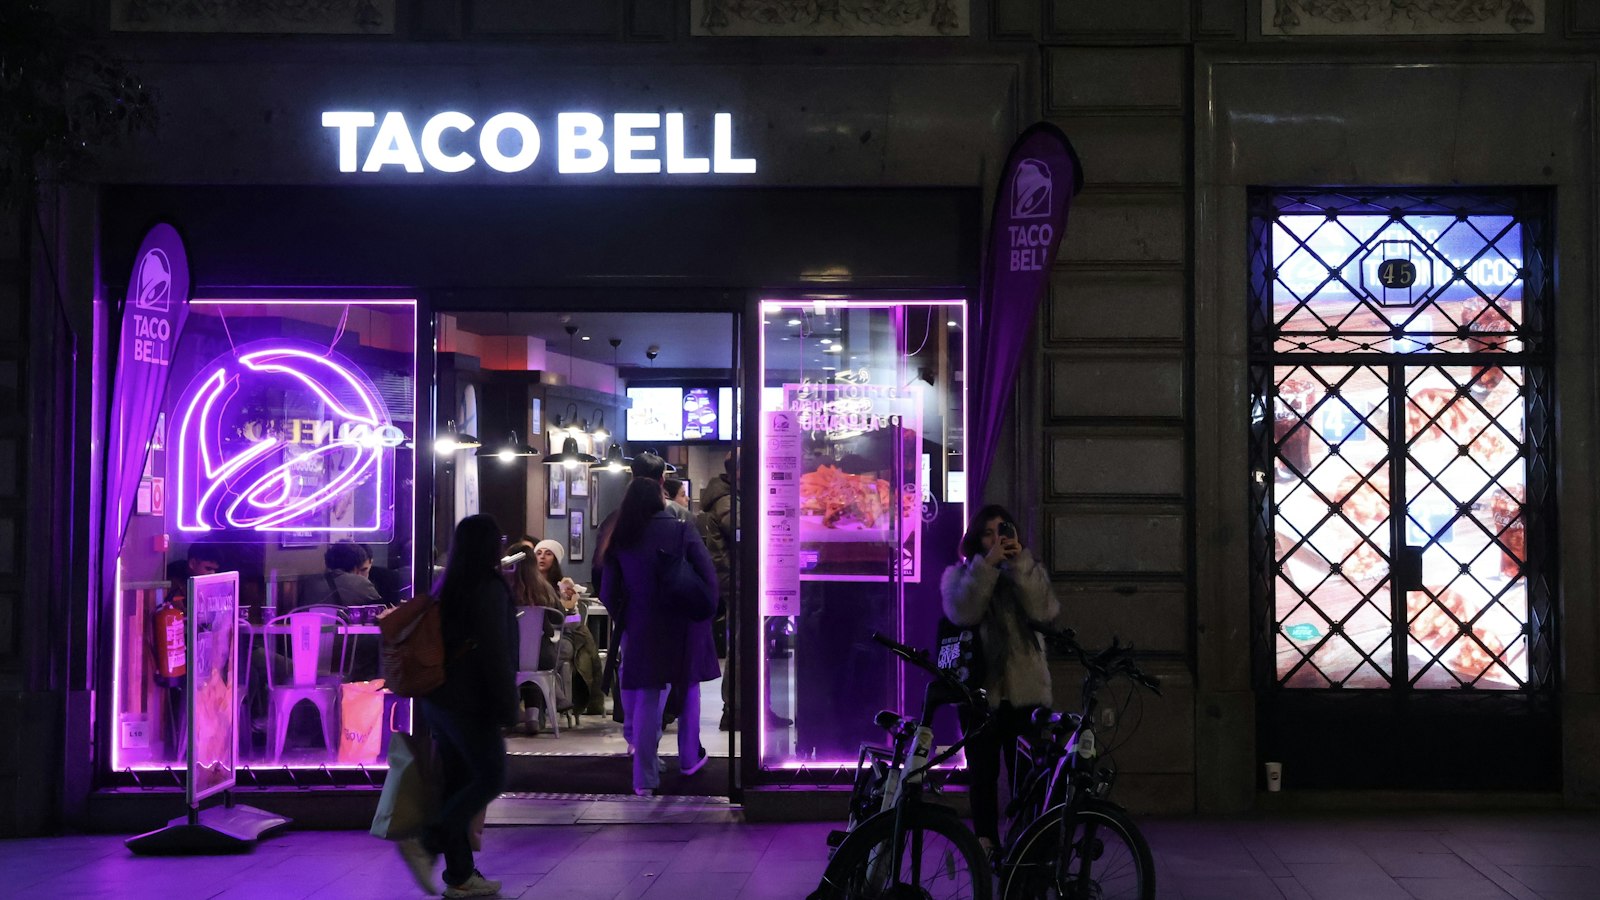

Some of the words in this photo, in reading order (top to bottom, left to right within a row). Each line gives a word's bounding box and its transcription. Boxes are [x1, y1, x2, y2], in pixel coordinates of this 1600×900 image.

[321, 111, 541, 173] TACO
[557, 111, 757, 174] BELL
[1008, 223, 1053, 247] TACO
[1383, 263, 1411, 284] 45
[133, 314, 171, 341] TACO
[134, 338, 169, 366] BELL
